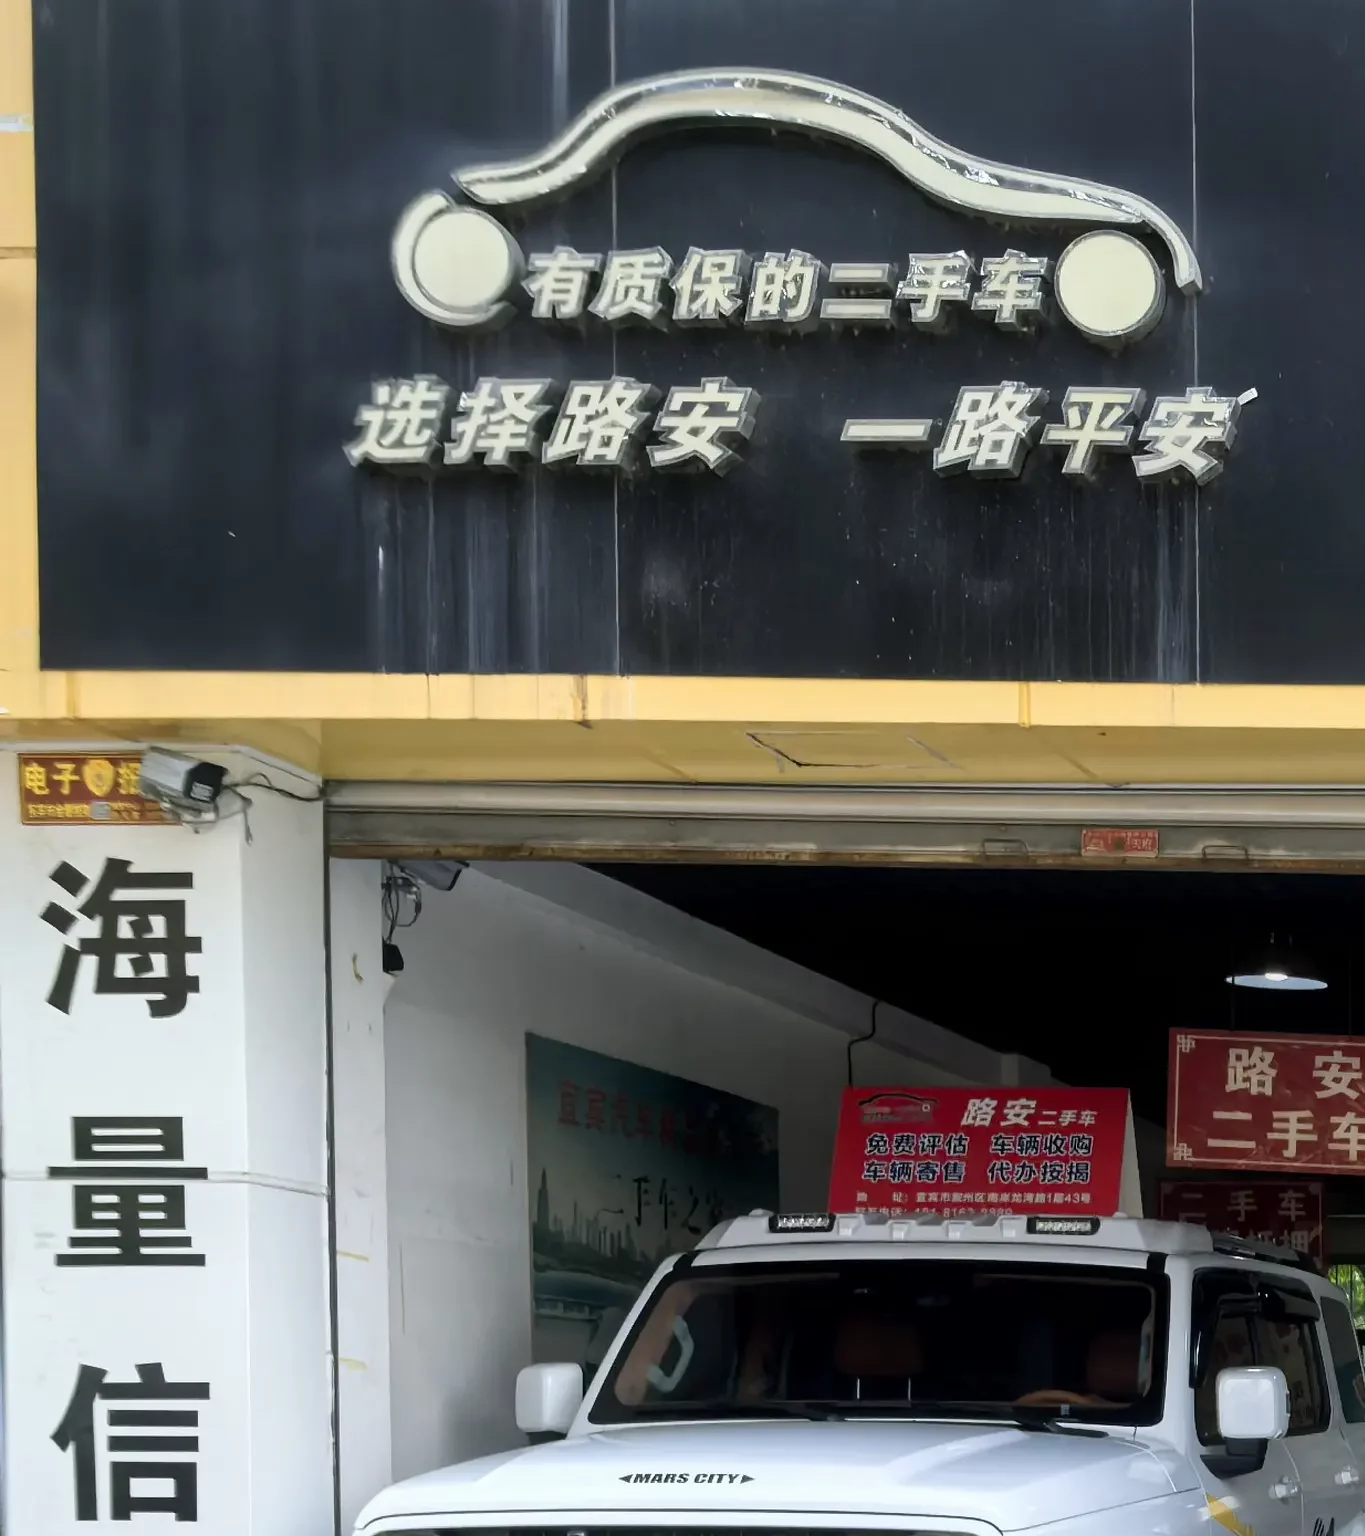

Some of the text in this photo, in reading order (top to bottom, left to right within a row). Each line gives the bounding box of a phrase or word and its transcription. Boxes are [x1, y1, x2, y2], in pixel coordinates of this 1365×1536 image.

[526, 245, 1053, 328] 有质保的二手车
[346, 374, 1243, 485] 选择路安 一路平安
[1226, 1047, 1363, 1101] 路安
[865, 1132, 1093, 1157] 免费评估 车辆收购
[861, 1160, 1092, 1184] 车辆寄售 代办按揭
[632, 1472, 740, 1484] MARS CITY
